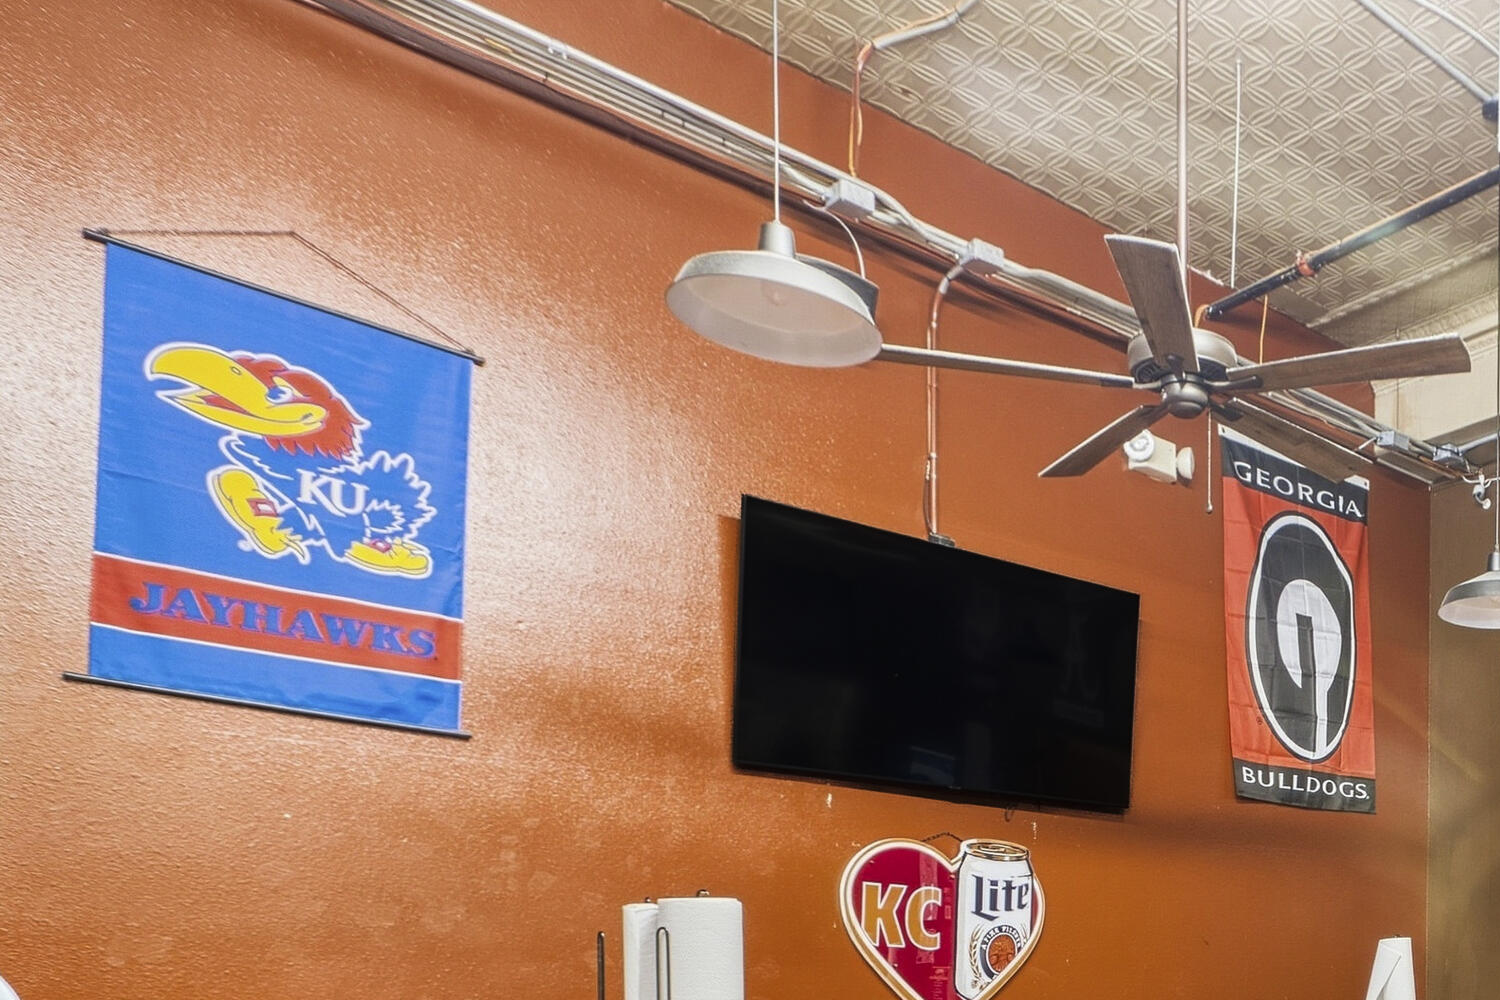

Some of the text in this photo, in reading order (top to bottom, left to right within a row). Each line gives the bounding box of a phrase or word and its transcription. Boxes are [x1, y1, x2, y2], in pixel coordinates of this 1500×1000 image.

[298, 468, 369, 517] KU
[1232, 460, 1366, 518] GEORGIA
[128, 581, 437, 660] JAYHAWKS
[1241, 765, 1368, 800] BULLDOGS
[861, 881, 943, 951] KC
[971, 873, 1031, 922] Lite
